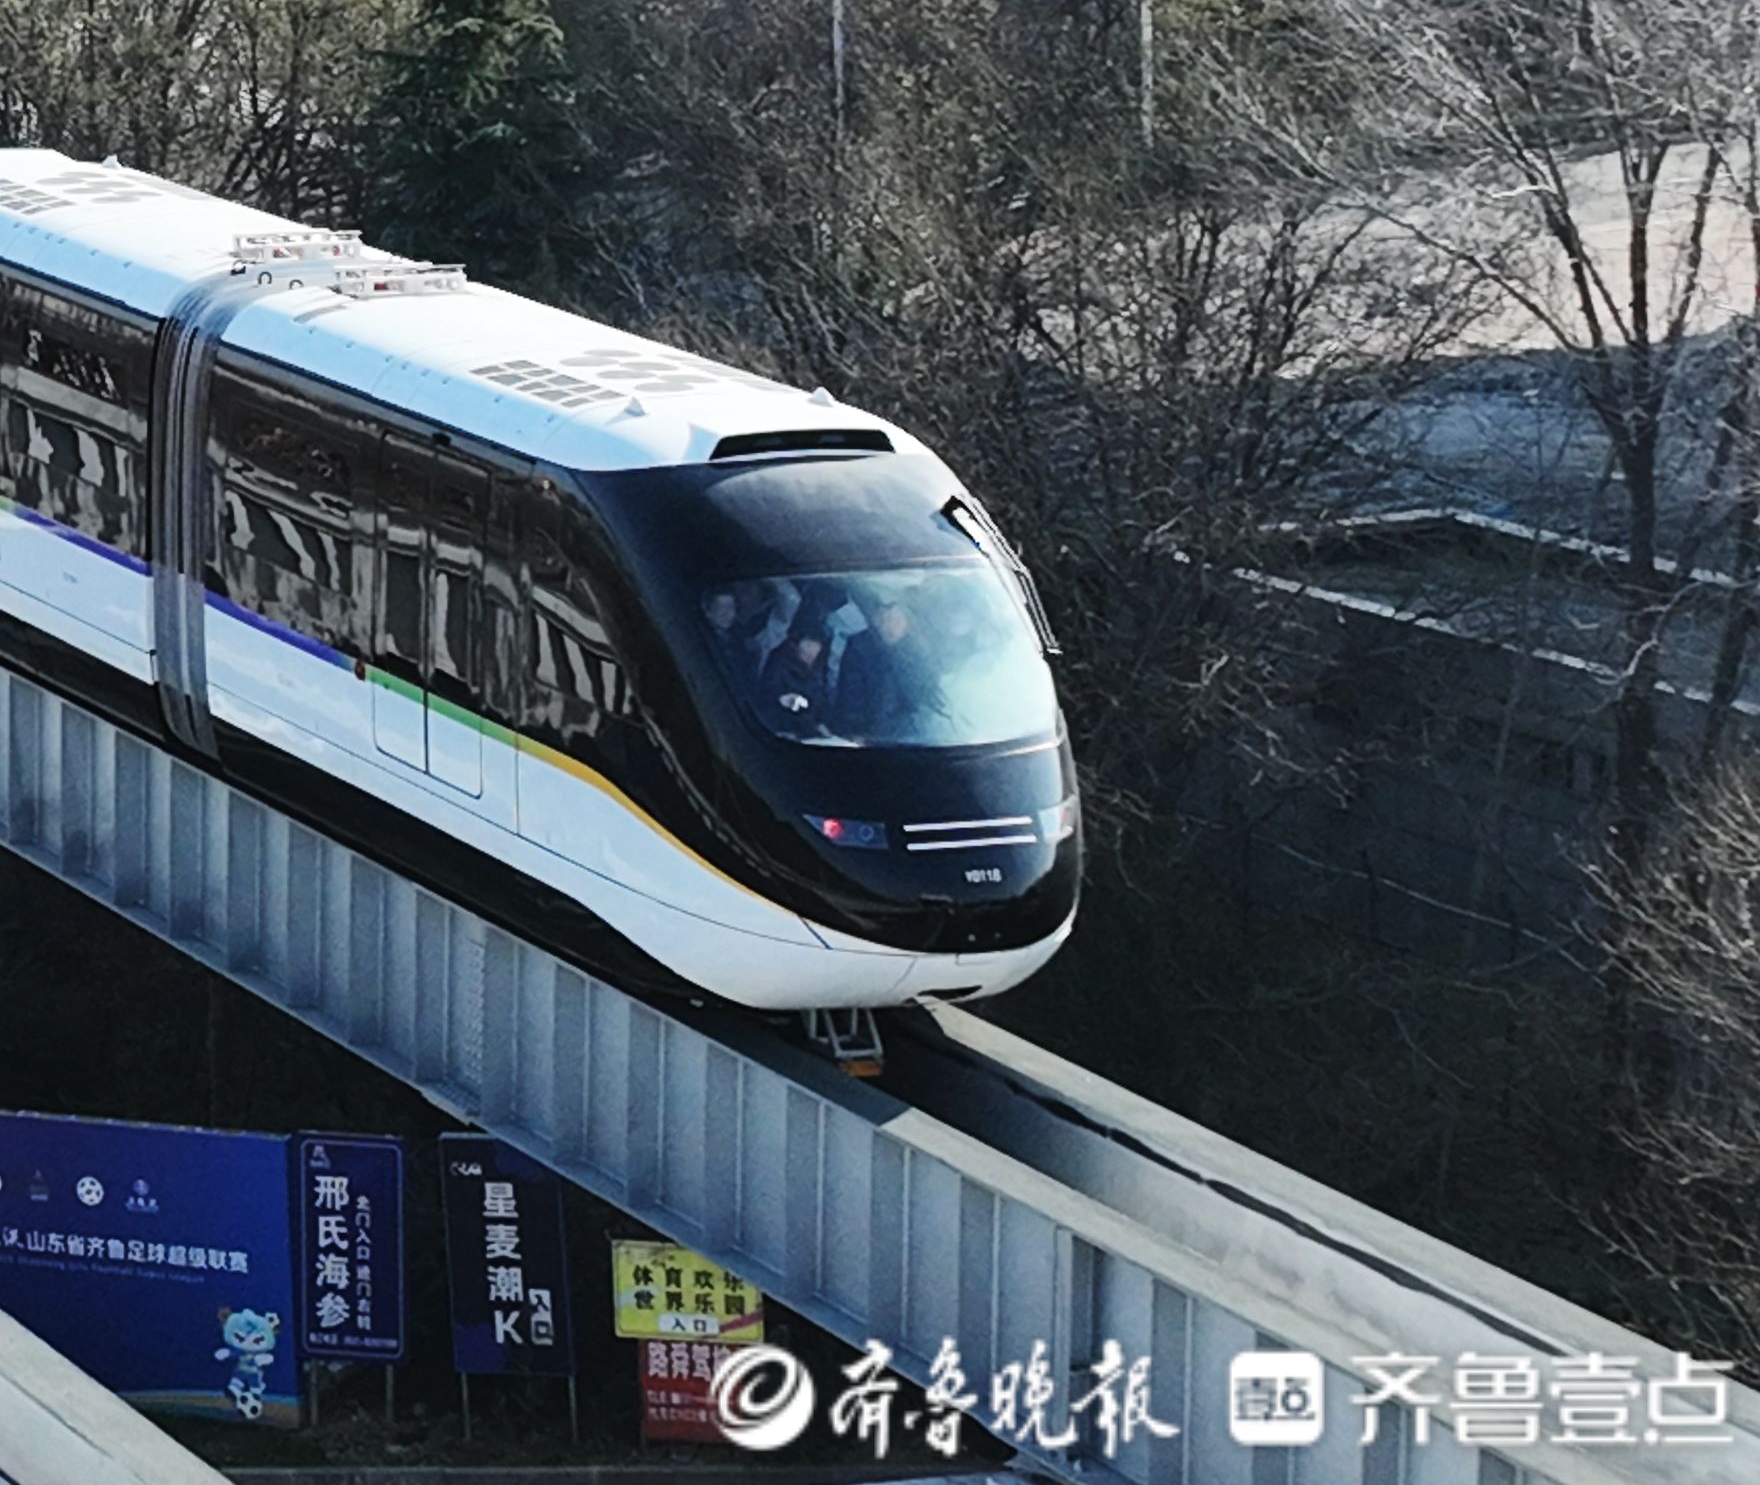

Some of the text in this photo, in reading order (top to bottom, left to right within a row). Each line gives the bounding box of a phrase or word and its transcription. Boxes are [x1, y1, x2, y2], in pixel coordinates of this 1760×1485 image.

[313, 1174, 350, 1328] 邢氏海参
[482, 1182, 524, 1344] 星麦潮K
[671, 1318, 708, 1333] 入口
